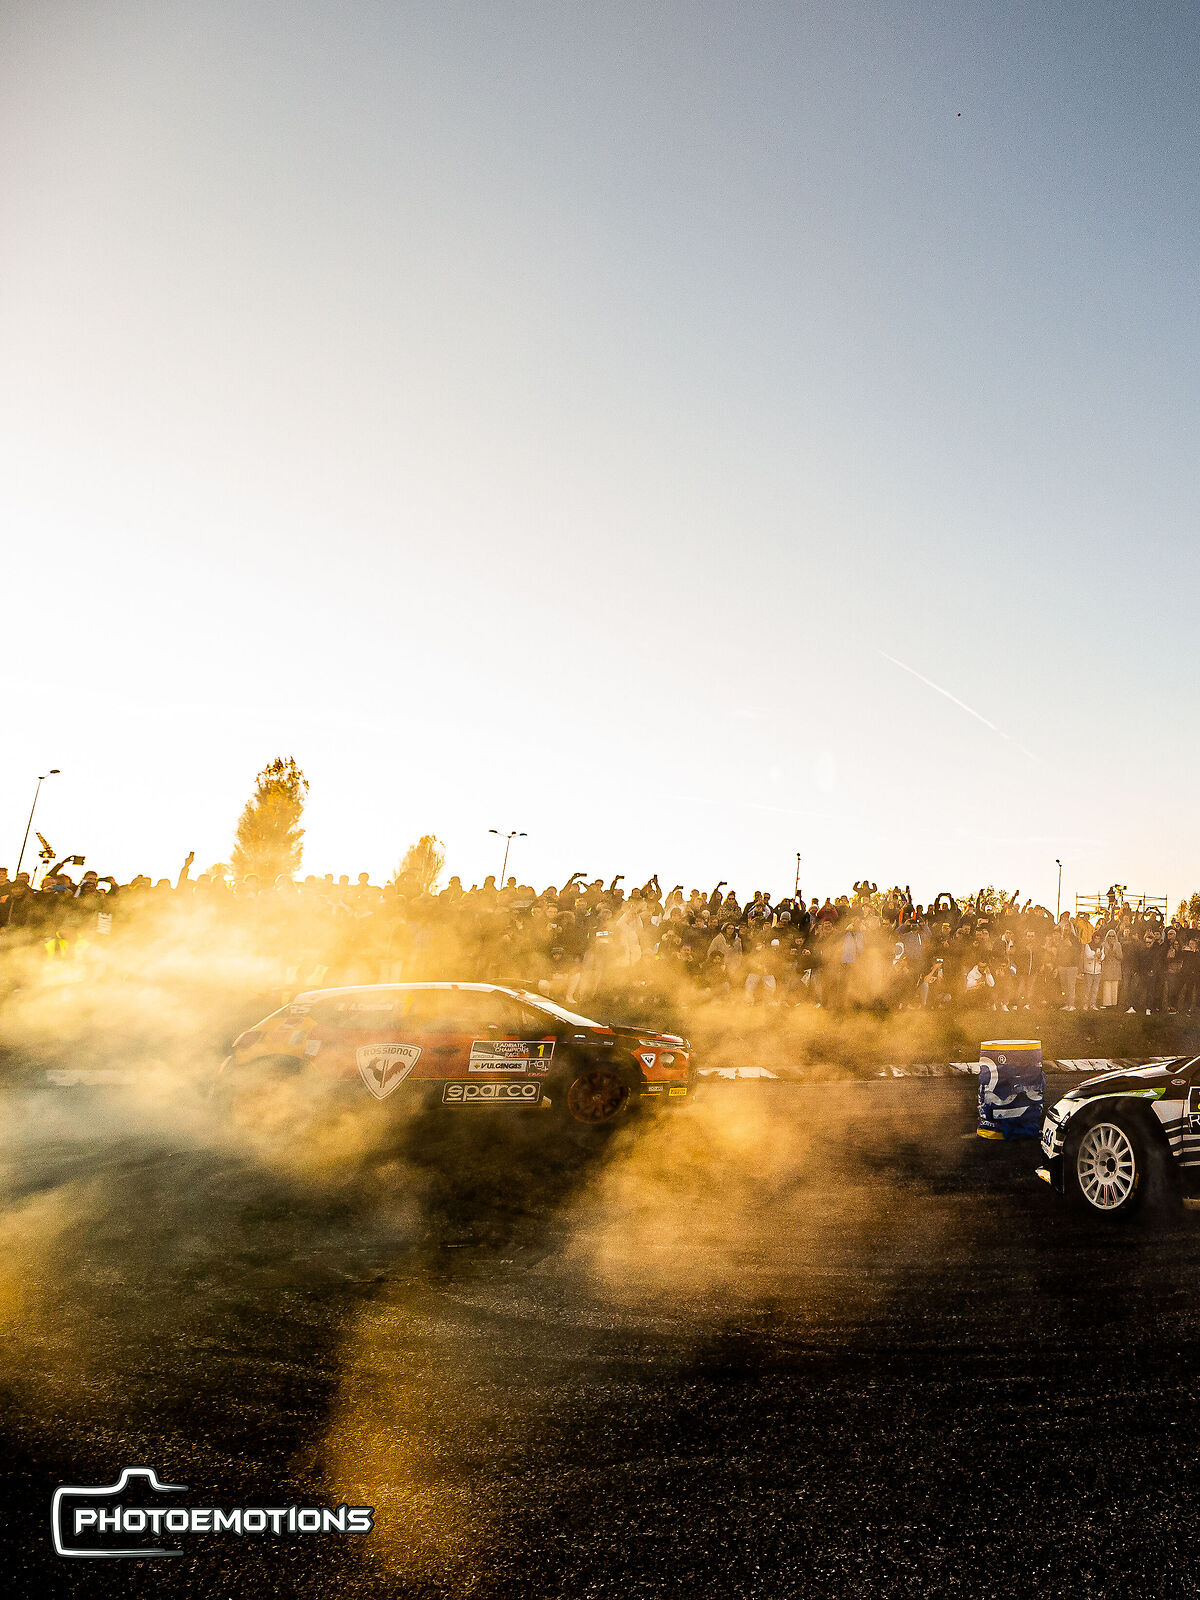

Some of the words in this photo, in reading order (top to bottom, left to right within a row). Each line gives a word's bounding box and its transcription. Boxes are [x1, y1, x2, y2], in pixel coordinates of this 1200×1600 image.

[363, 1047, 413, 1057] ROSSIGNOL
[537, 1044, 545, 1057] 1
[447, 1084, 537, 1101] sparco
